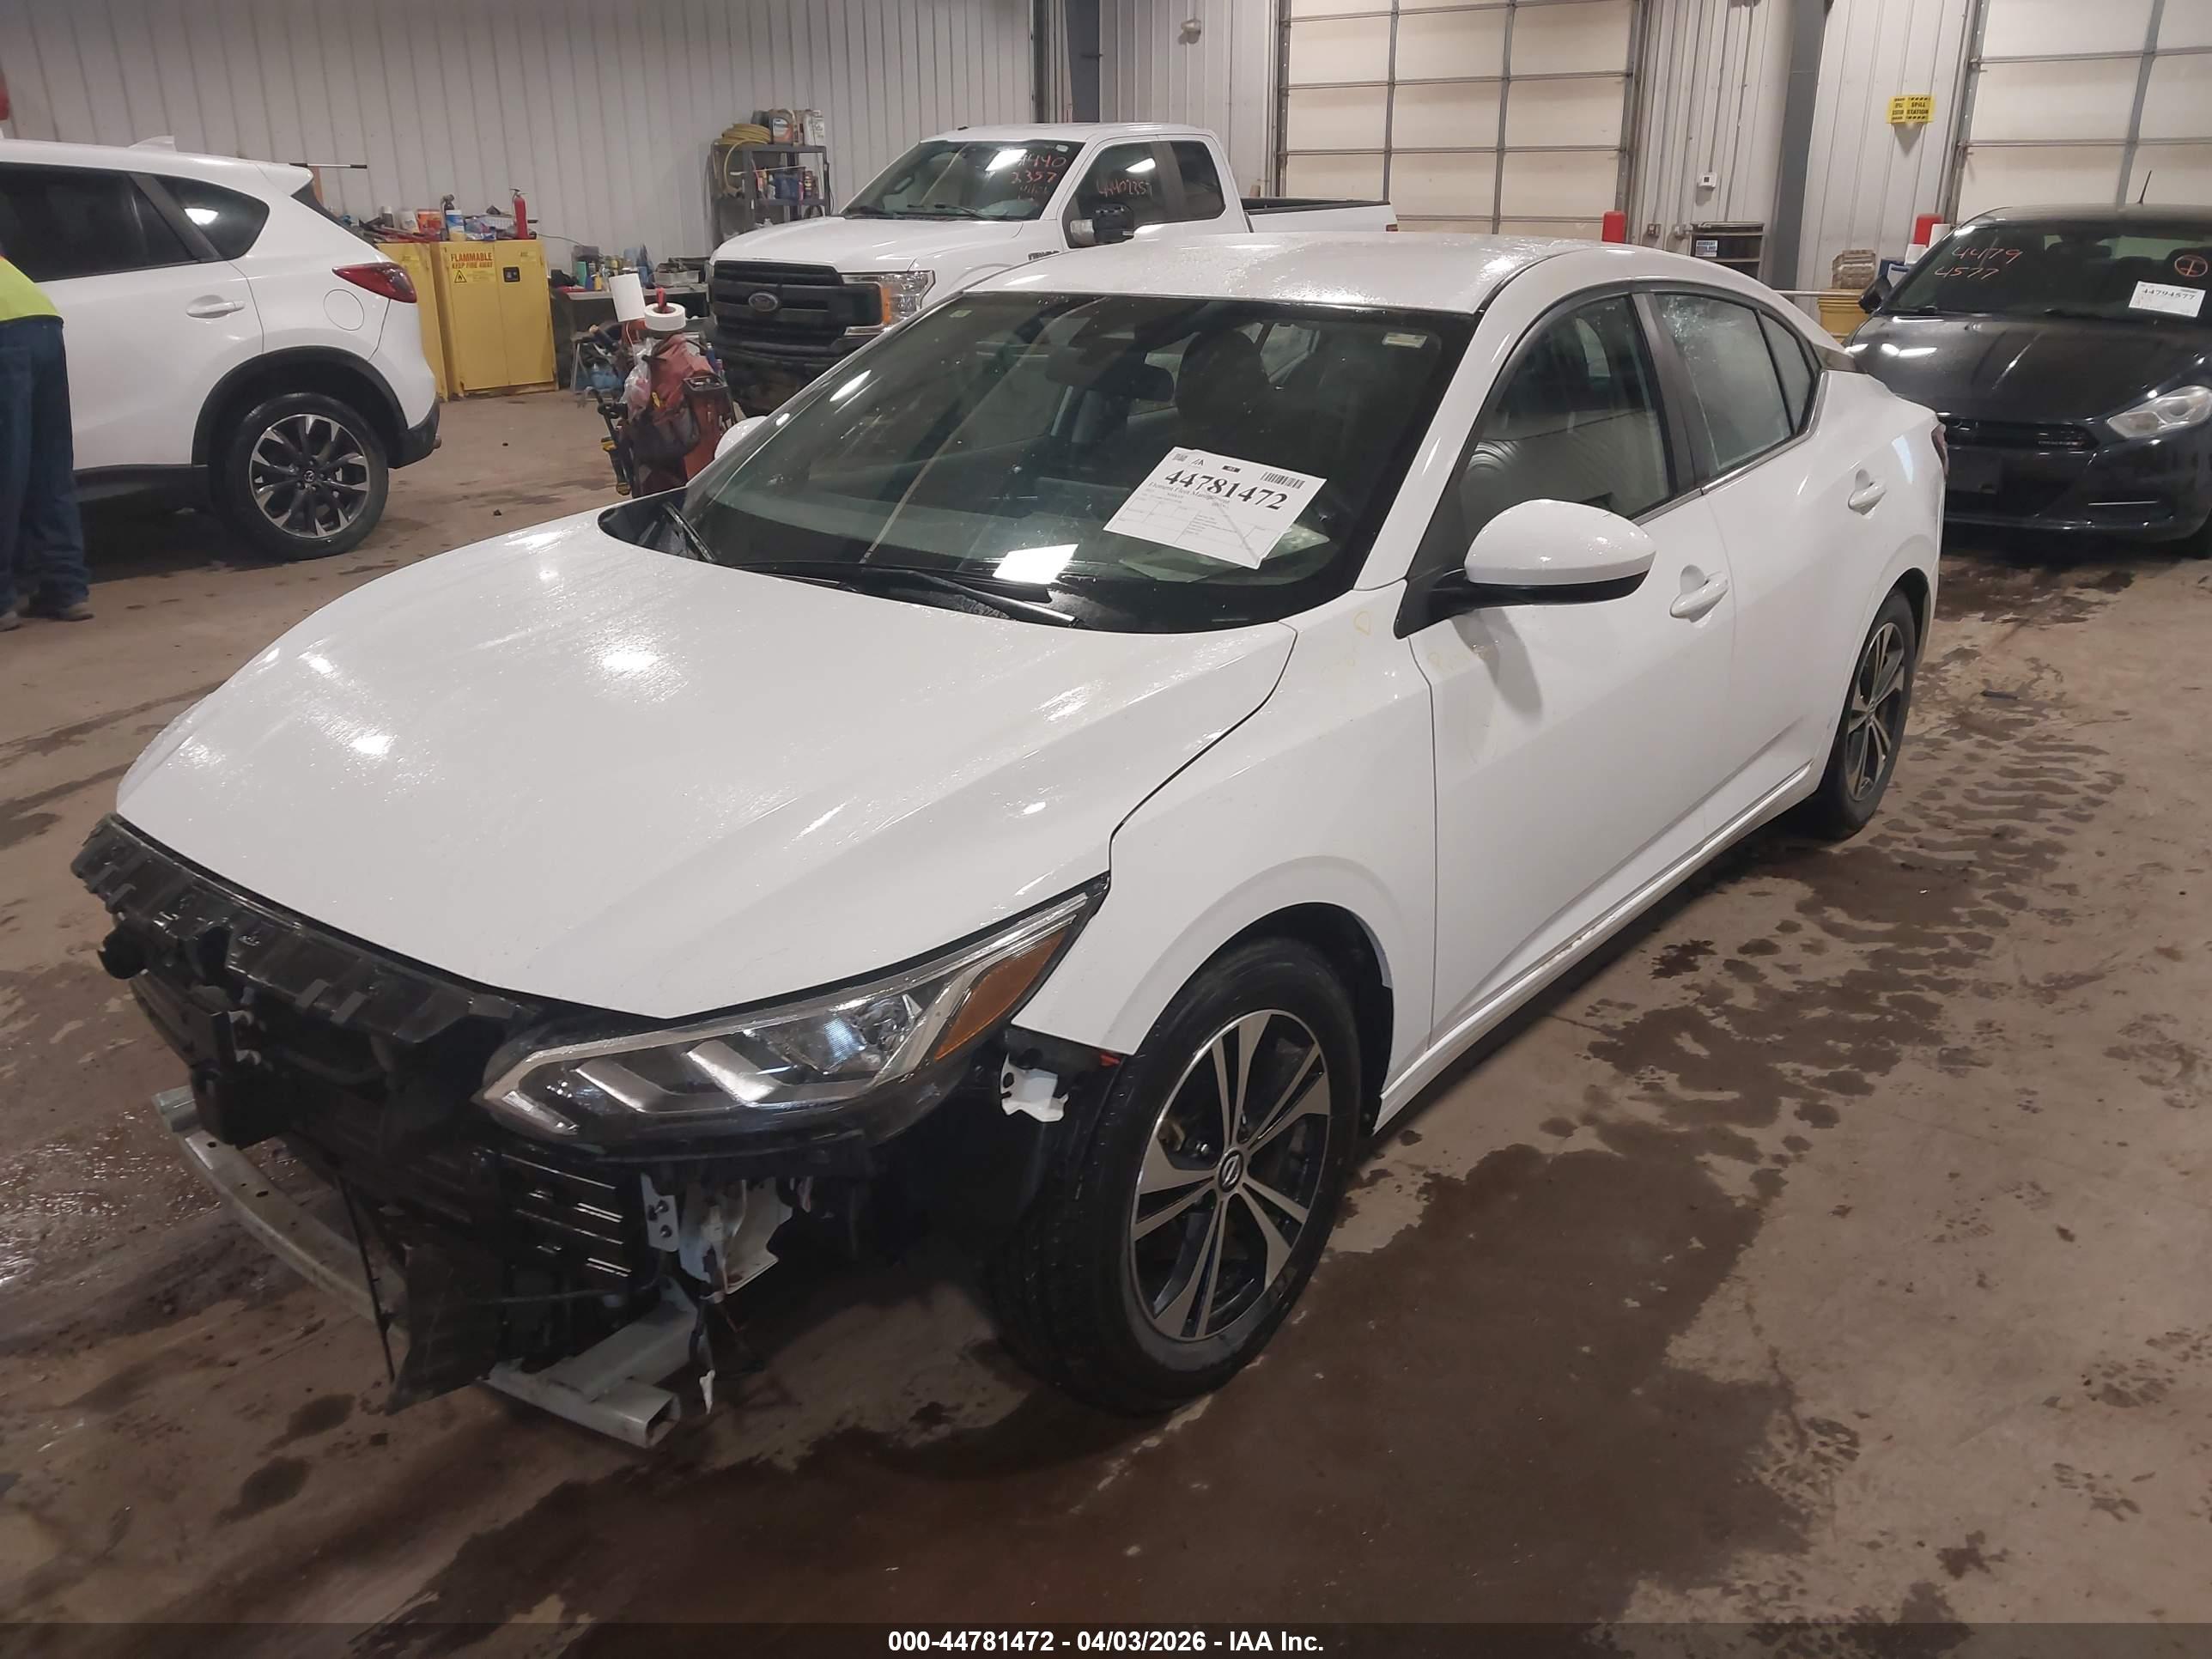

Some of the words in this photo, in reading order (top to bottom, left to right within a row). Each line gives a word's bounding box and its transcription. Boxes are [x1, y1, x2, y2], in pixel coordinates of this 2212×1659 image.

[1012, 171, 1057, 184] 2357
[450, 252, 493, 261] FLAMMABLE
[1952, 247, 2023, 264] 4479
[1935, 267, 2000, 280] 4577
[1164, 470, 1288, 510] 44781472
